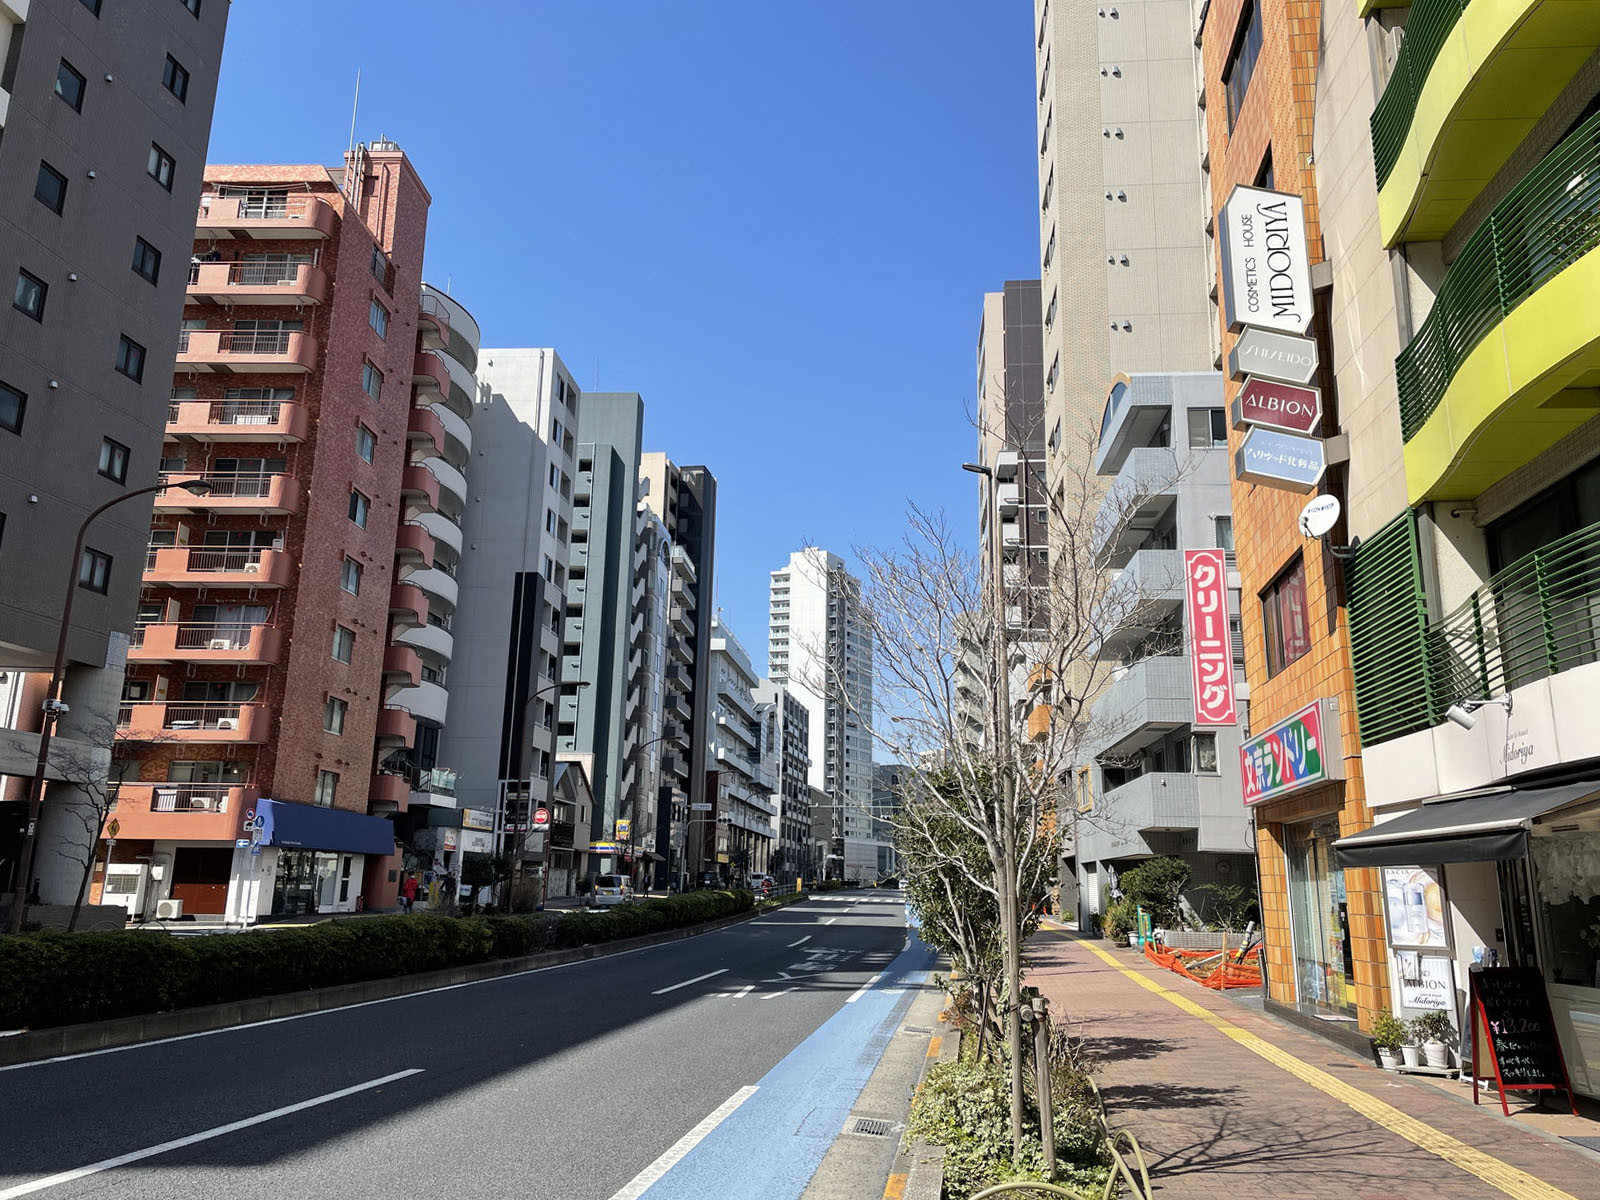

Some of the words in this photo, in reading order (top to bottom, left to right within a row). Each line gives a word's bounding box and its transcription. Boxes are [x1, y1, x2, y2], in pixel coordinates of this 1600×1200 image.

[1242, 213, 1255, 248] HOUSE
[1256, 200, 1302, 324] MIDORIYA
[1244, 257, 1260, 313] COSMETICS
[1245, 343, 1313, 368] SHISEIDO
[1244, 393, 1315, 419] ALBION
[1193, 563, 1228, 710] クリーニング
